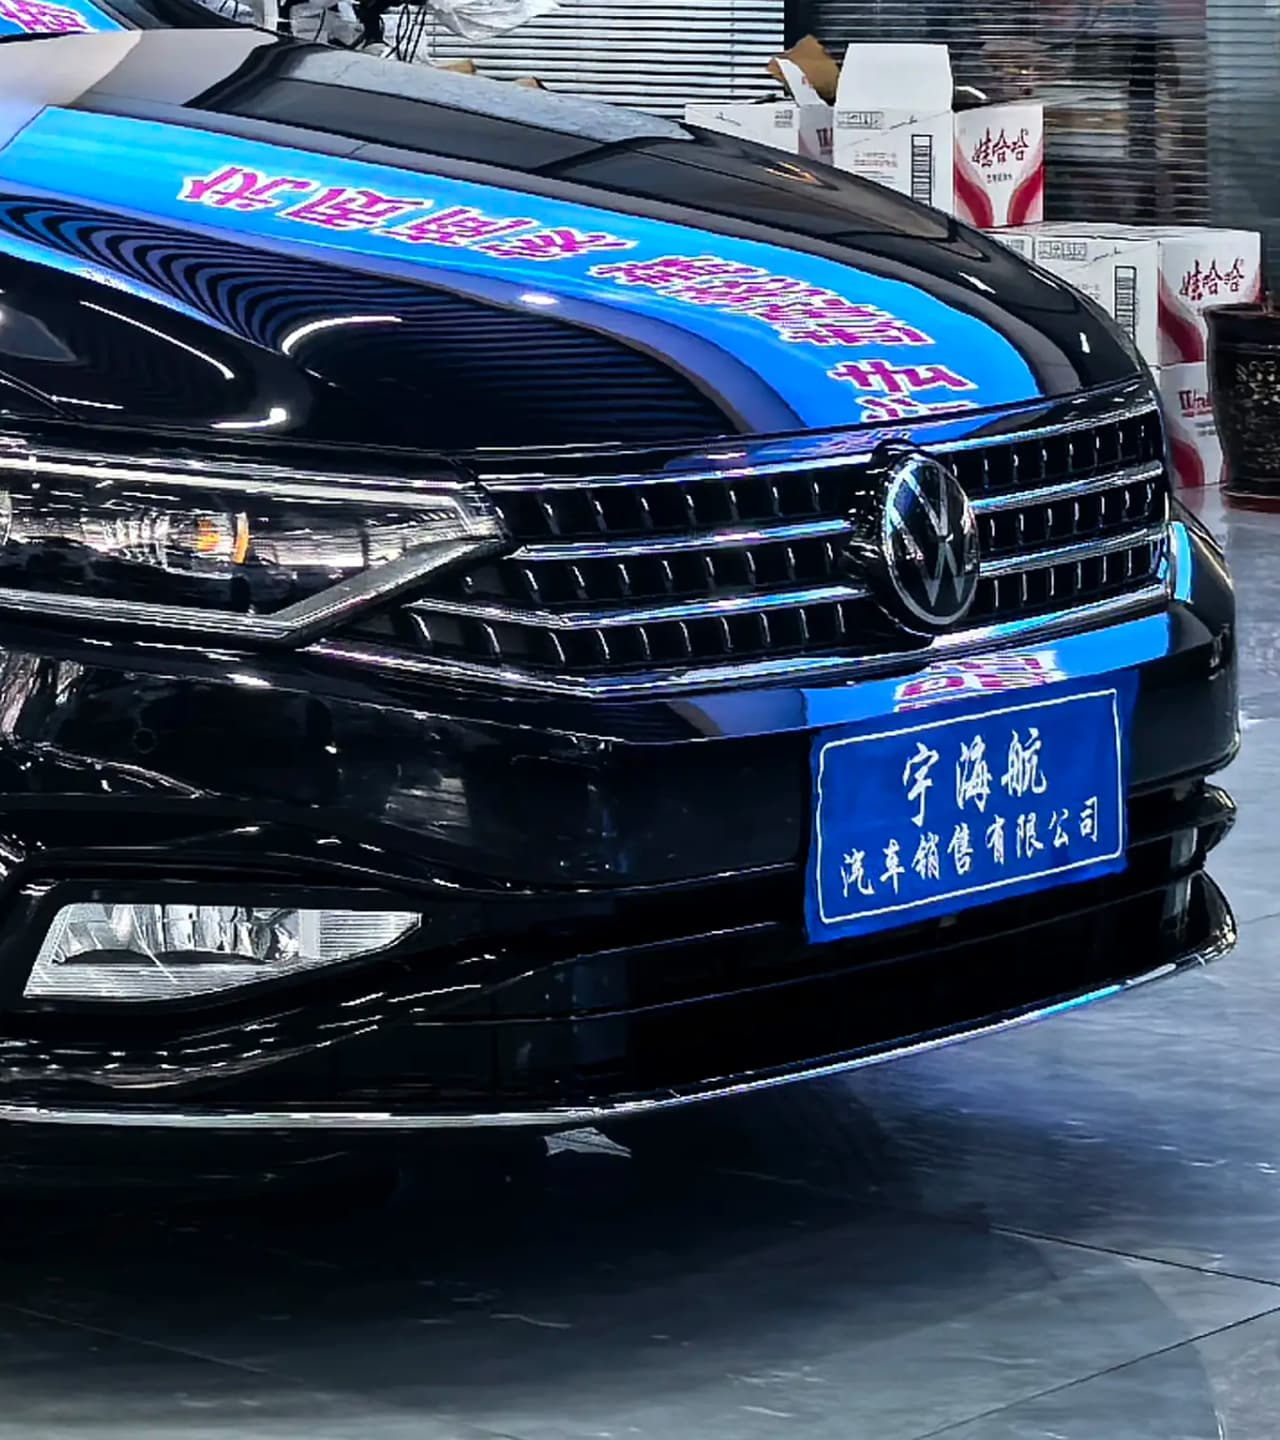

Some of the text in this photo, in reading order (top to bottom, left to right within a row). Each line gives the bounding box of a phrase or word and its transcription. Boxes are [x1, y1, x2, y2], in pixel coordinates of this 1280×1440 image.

[971, 127, 1028, 168] 娃哈哈
[1178, 257, 1246, 302] 娃哈哈
[901, 727, 1048, 828] 宇海航
[839, 795, 1099, 898] 汽车销售有限公司
